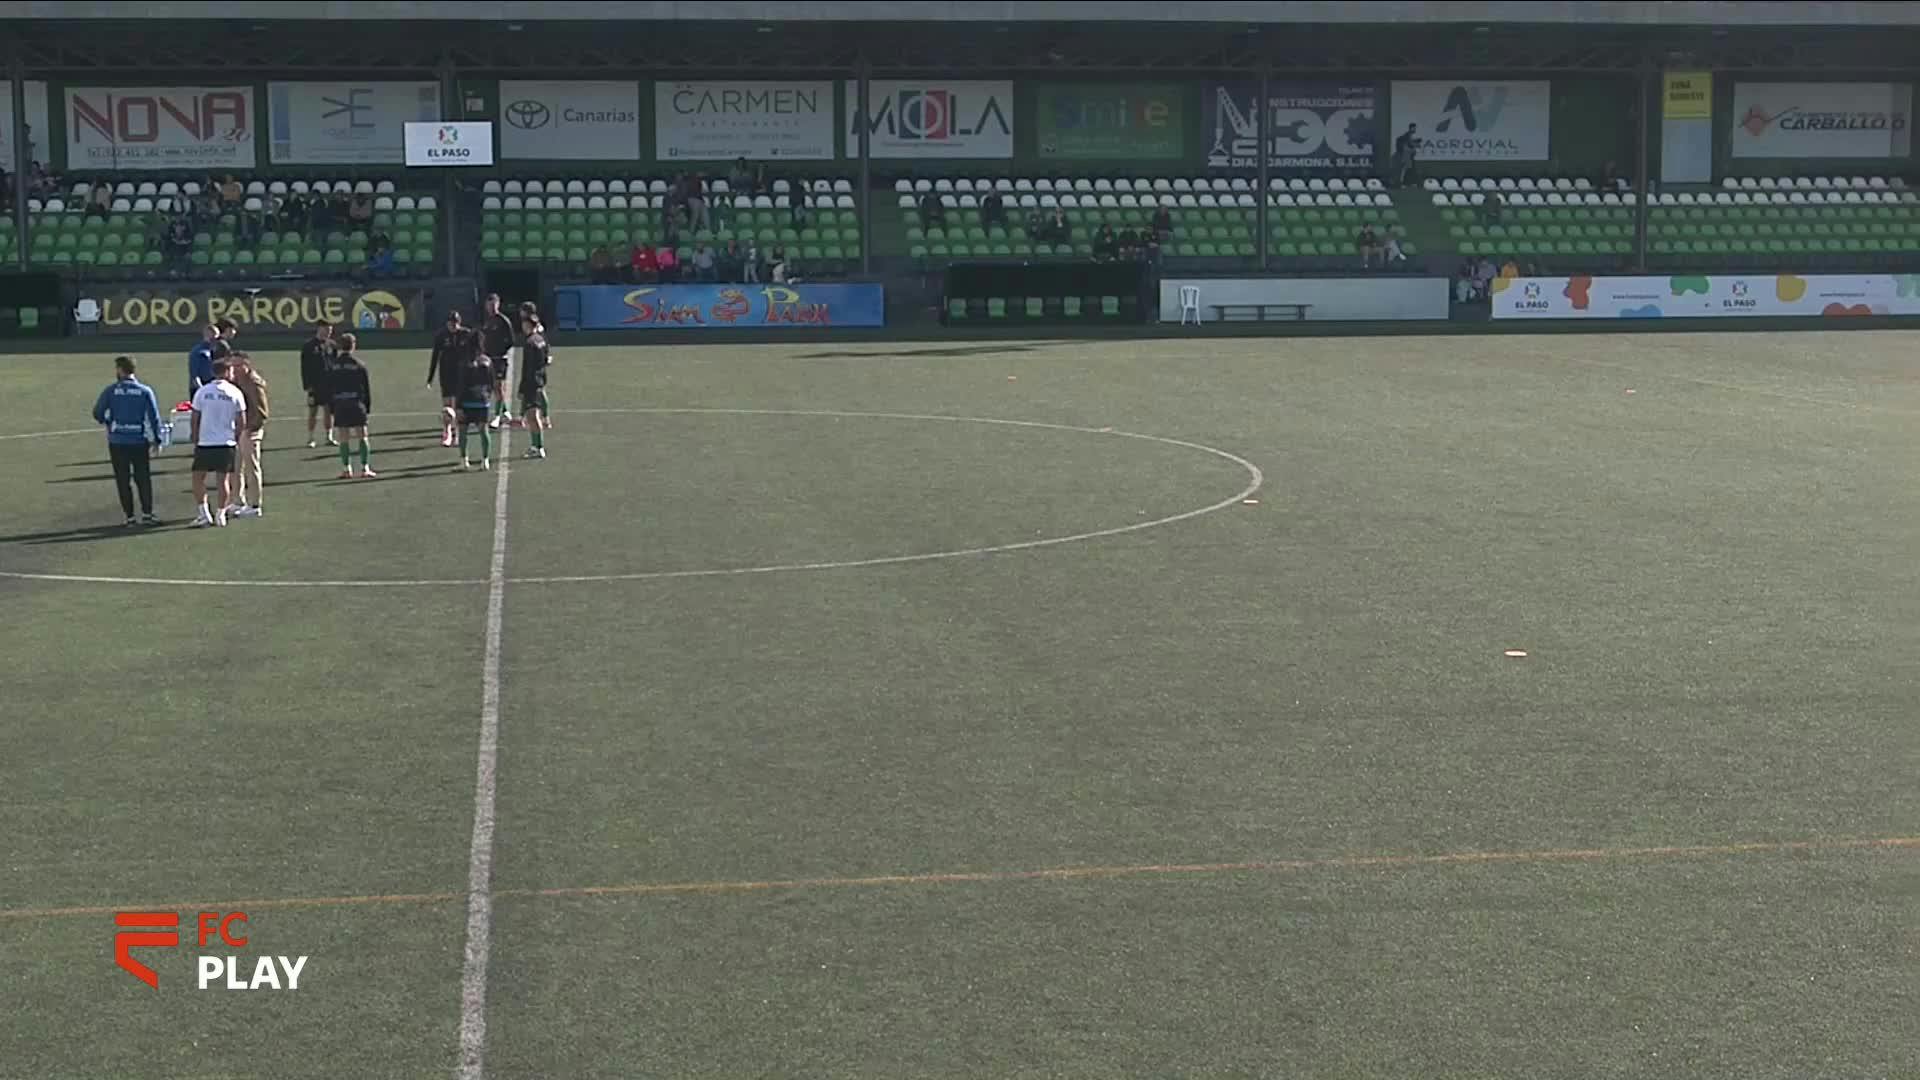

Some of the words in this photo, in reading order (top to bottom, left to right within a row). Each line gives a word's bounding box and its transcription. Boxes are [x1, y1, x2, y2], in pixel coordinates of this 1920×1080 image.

[562, 106, 635, 123] Canarias
[673, 89, 817, 114] CARMEN
[851, 89, 1011, 140] MOLA
[72, 92, 246, 144] NOVA
[1231, 157, 1258, 168] DIA
[103, 298, 197, 326] LORO
[208, 296, 345, 328] PARQUE
